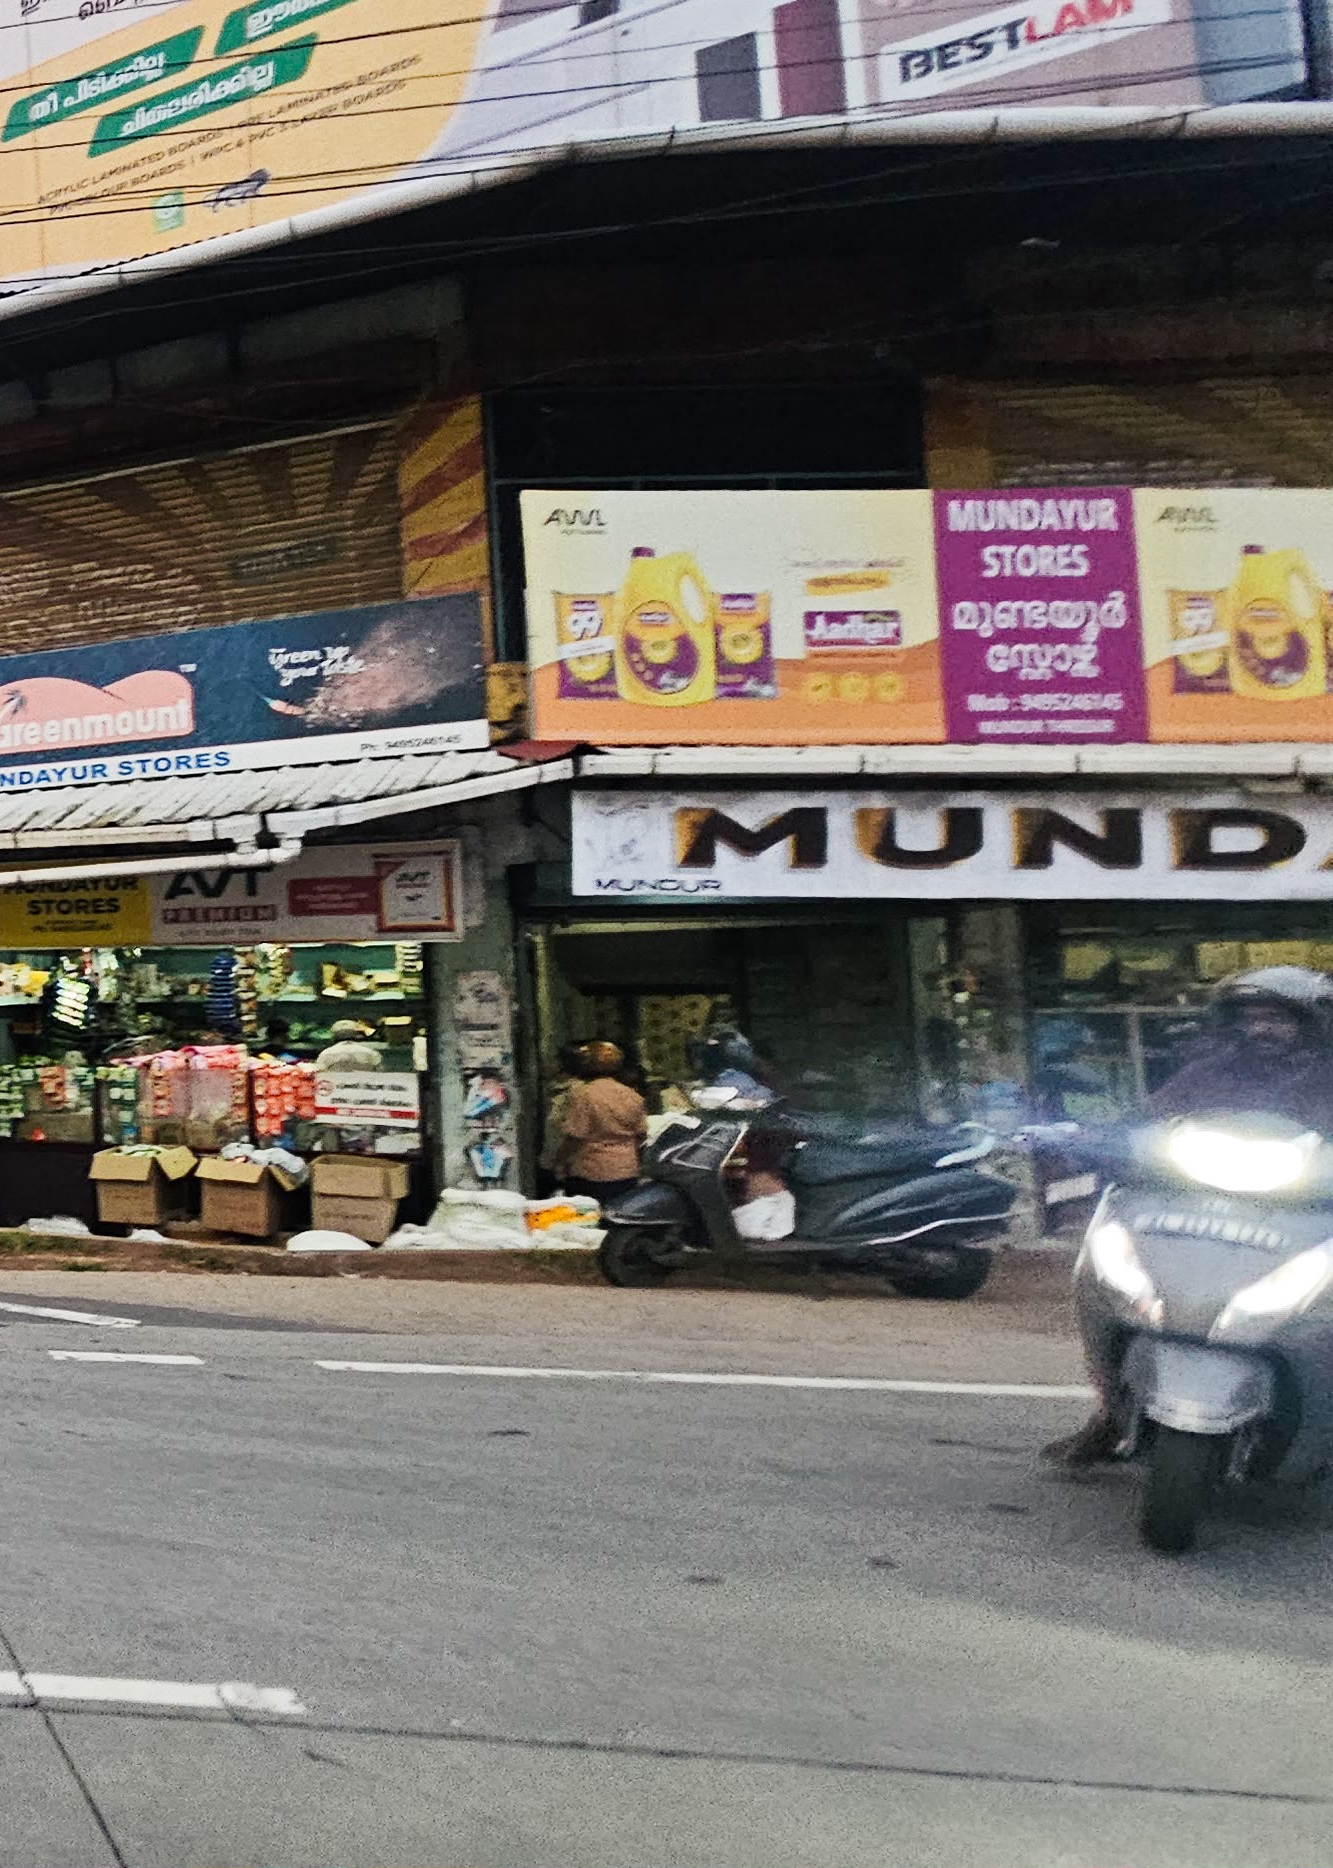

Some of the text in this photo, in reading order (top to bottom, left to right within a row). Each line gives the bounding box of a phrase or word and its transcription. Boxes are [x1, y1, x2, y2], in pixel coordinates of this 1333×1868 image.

[37, 178, 89, 204] ACRYLIC
[91, 150, 166, 184] LAMINATED
[947, 498, 1119, 532] MUNDAYUR
[981, 543, 1091, 578] STORES
[118, 750, 231, 775] STORES
[671, 805, 1333, 870] MUND
[164, 863, 275, 901] AVT
[596, 868, 722, 893] MUNDUR
[26, 897, 122, 916] STORES
[164, 905, 278, 924] PREMIUM
